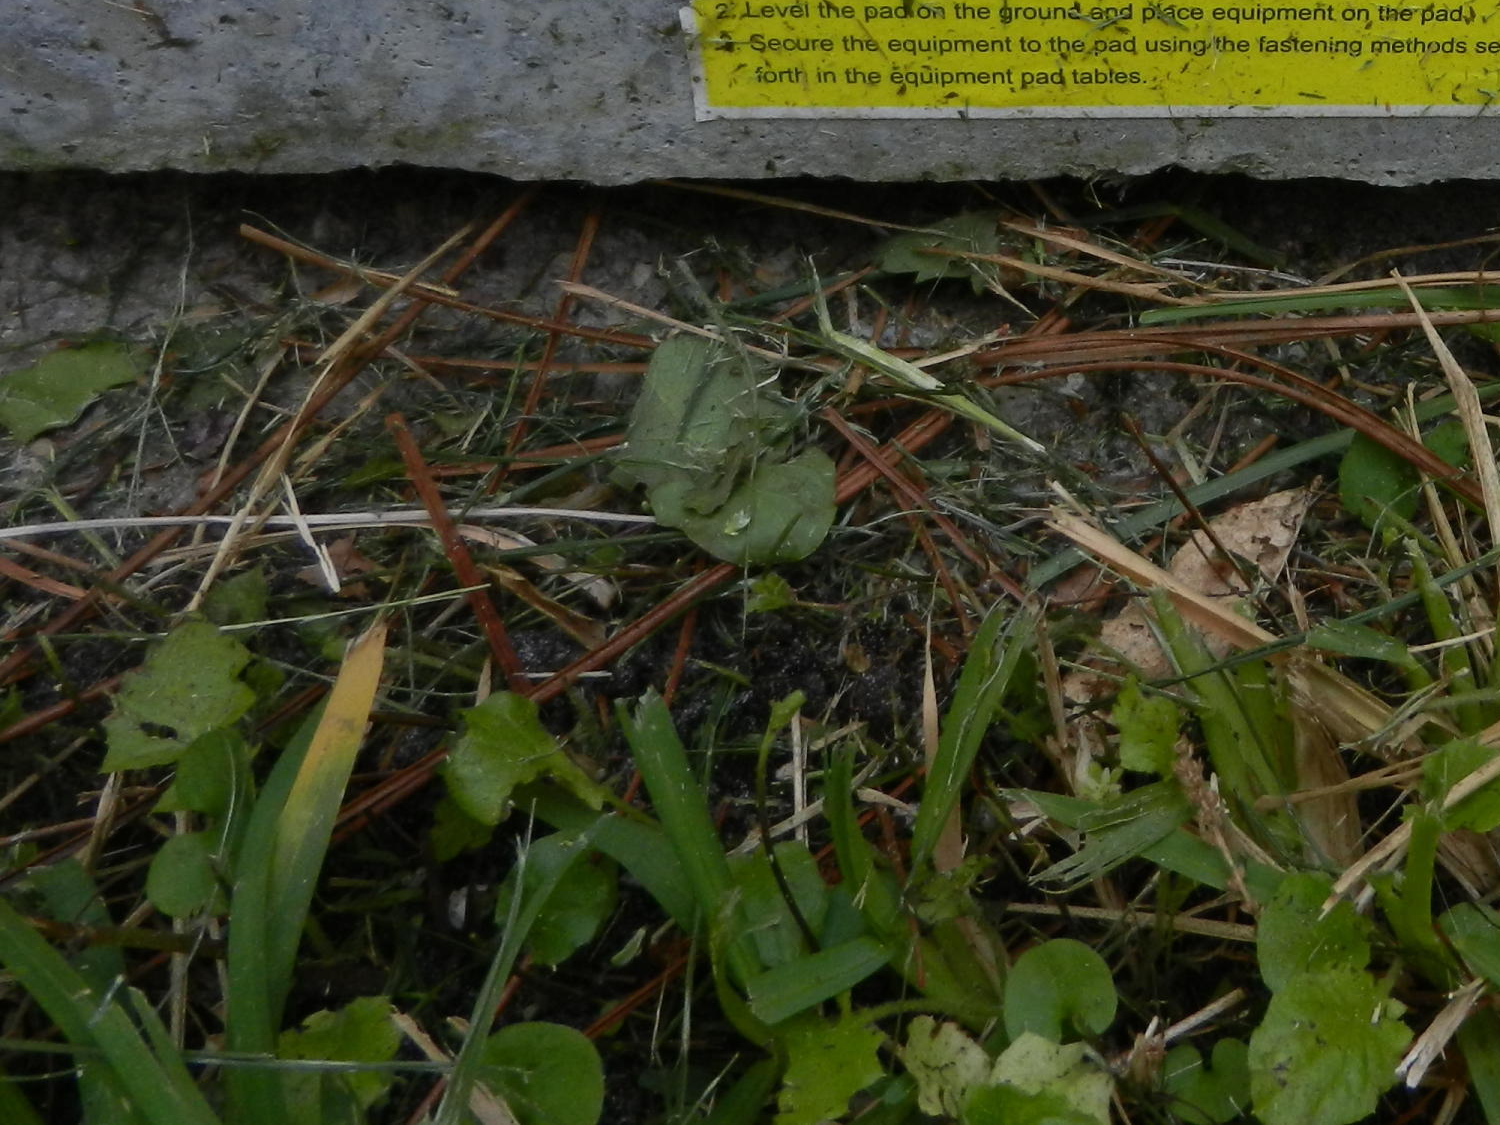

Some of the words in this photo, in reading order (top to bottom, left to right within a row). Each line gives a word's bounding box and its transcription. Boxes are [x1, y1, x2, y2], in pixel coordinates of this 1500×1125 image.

[715, 2, 737, 20] 2.
[744, 1, 810, 20] Level
[818, 2, 855, 20] the
[864, 3, 911, 23] pad
[917, 6, 946, 20] on
[954, 3, 991, 21] the
[999, 4, 1081, 25] ground
[1090, 3, 1133, 21] and
[1212, 4, 1334, 25] equipment
[1341, 7, 1370, 22] on
[1378, 5, 1413, 22] the
[750, 33, 834, 52] Secure
[843, 34, 880, 52] the
[888, 35, 1012, 56] equipment
[1020, 37, 1042, 53] to
[1048, 35, 1085, 53] the
[1095, 36, 1136, 56] pad
[1145, 36, 1207, 57] using
[1216, 36, 1250, 53] the
[1259, 36, 1363, 58] fastening
[1370, 37, 1467, 54] methods
[755, 67, 804, 85] forth
[817, 67, 837, 84] in
[845, 67, 882, 85] the
[890, 67, 1013, 88] equipment
[1021, 68, 1064, 89] pad
[1072, 68, 1148, 85] tables.
